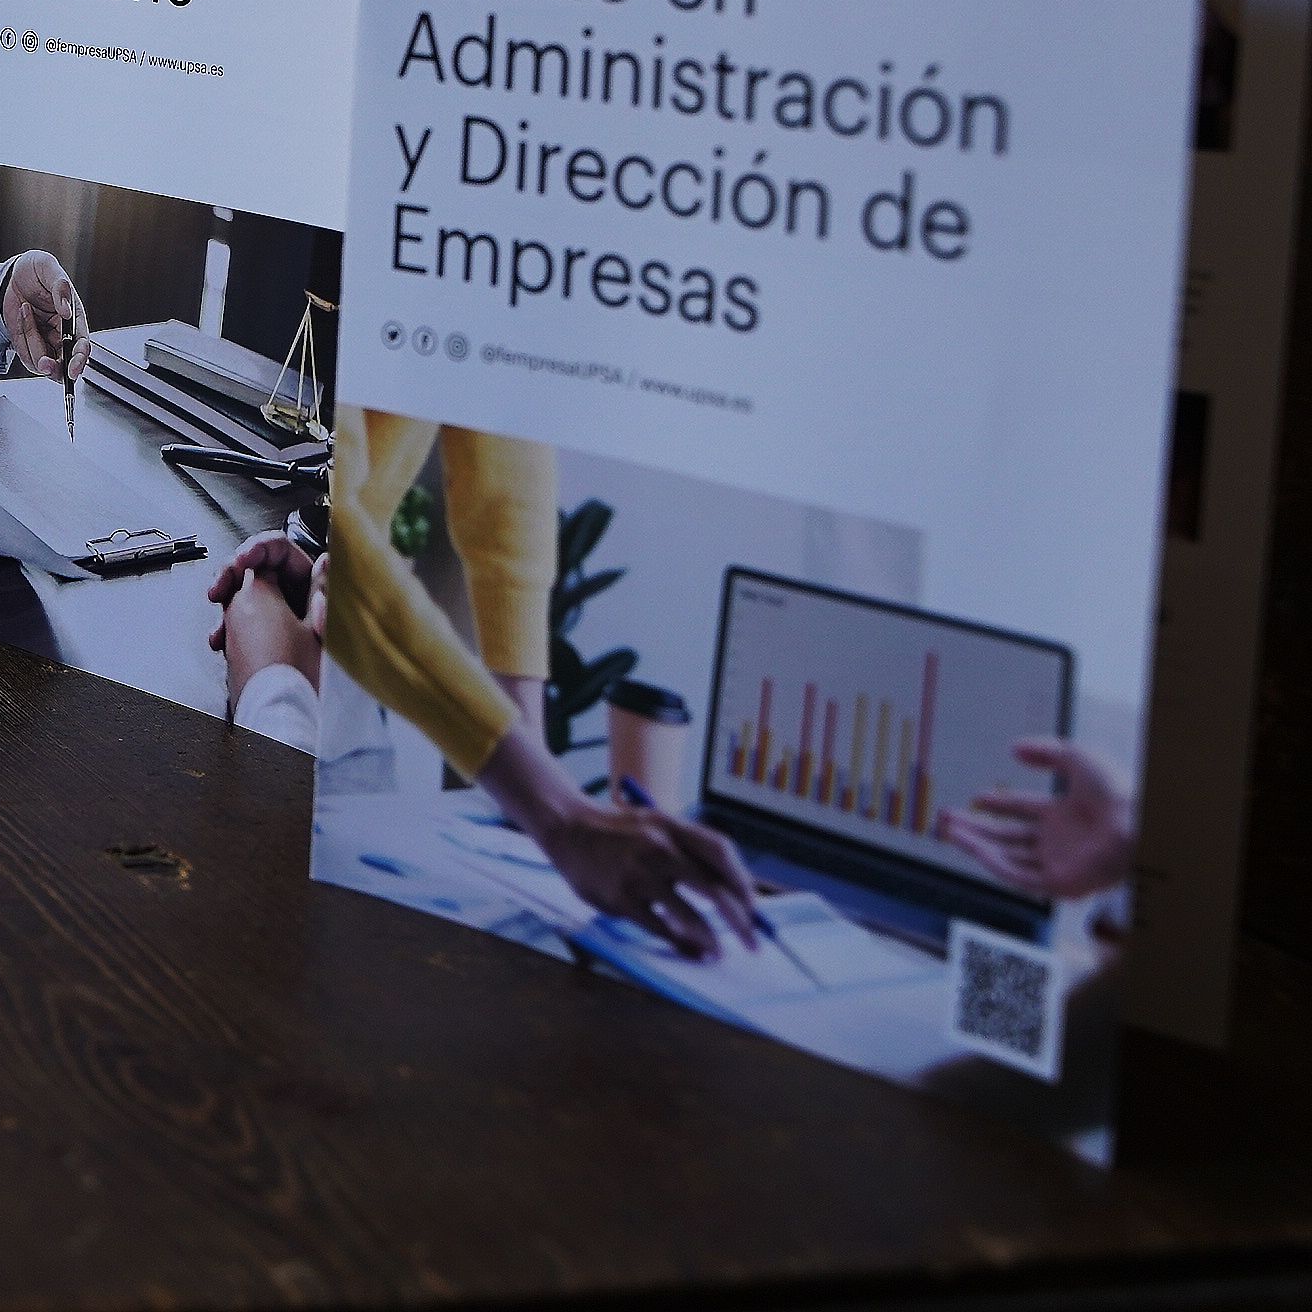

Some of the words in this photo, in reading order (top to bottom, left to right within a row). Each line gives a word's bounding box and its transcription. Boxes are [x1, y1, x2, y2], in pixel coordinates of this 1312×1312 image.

[45, 37, 137, 64] @fempresaUPSA
[148, 55, 224, 77] www.upsa.es
[398, 13, 1011, 155] Administración
[394, 121, 431, 192] y
[461, 116, 832, 239] Dirección
[862, 171, 973, 262] de
[391, 204, 762, 333] Empresas
